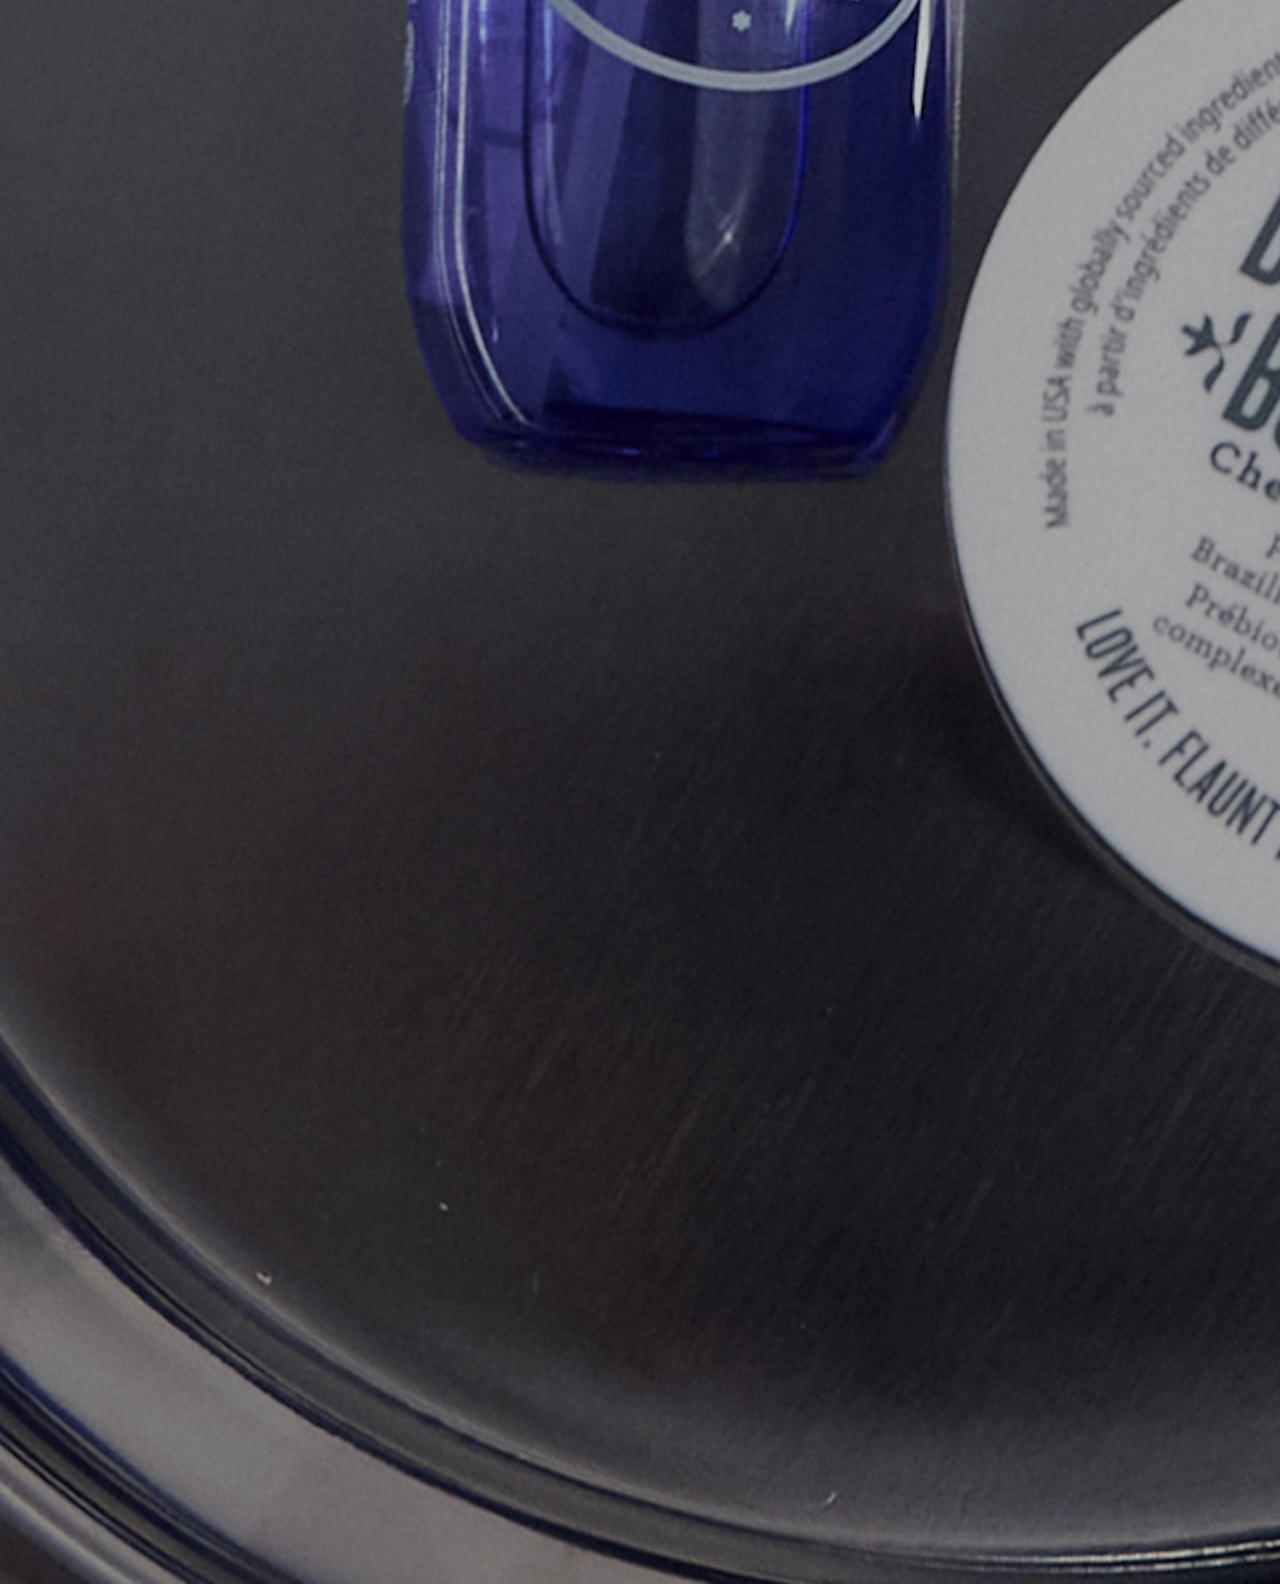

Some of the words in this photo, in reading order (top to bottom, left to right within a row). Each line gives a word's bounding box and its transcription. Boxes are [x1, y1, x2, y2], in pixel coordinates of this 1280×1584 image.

[1115, 132, 1186, 222] sourced
[1069, 219, 1131, 316] globally
[1095, 325, 1127, 397] partir
[1205, 145, 1236, 176] de
[1055, 316, 1085, 370] with
[1042, 374, 1073, 423] USA
[1045, 428, 1066, 452] in
[1039, 457, 1069, 530] Made
[1075, 608, 1155, 704] LOVE
[1124, 690, 1179, 748] IT.
